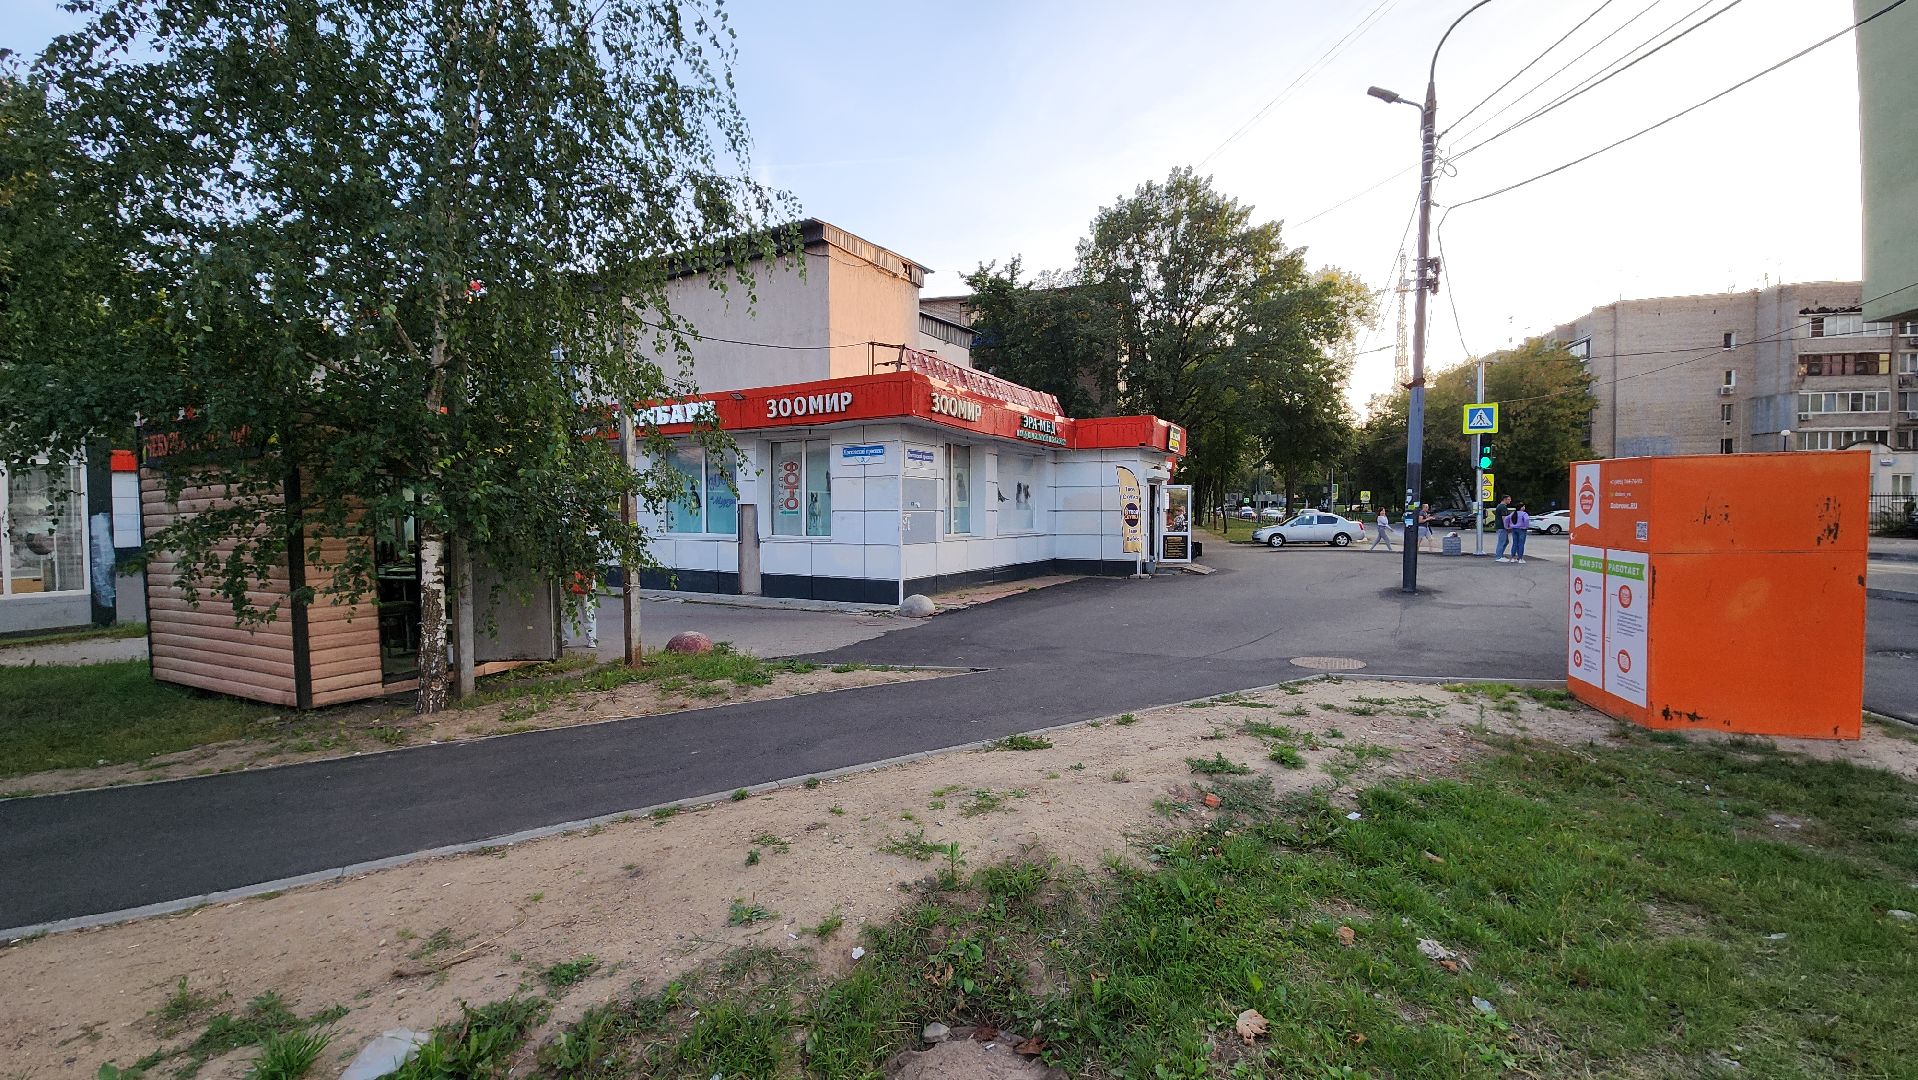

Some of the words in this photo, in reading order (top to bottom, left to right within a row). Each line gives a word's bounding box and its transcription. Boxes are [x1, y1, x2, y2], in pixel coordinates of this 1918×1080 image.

[766, 391, 853, 418] ЗООМИР
[931, 393, 981, 422] ЗООМИР
[1023, 415, 1056, 435] ЭРА-МЕД
[784, 461, 799, 510] ФОТО
[1579, 558, 1590, 568] КАК
[1591, 560, 1602, 570] ЭТО
[1608, 562, 1640, 576] РАБОТАЕТ
